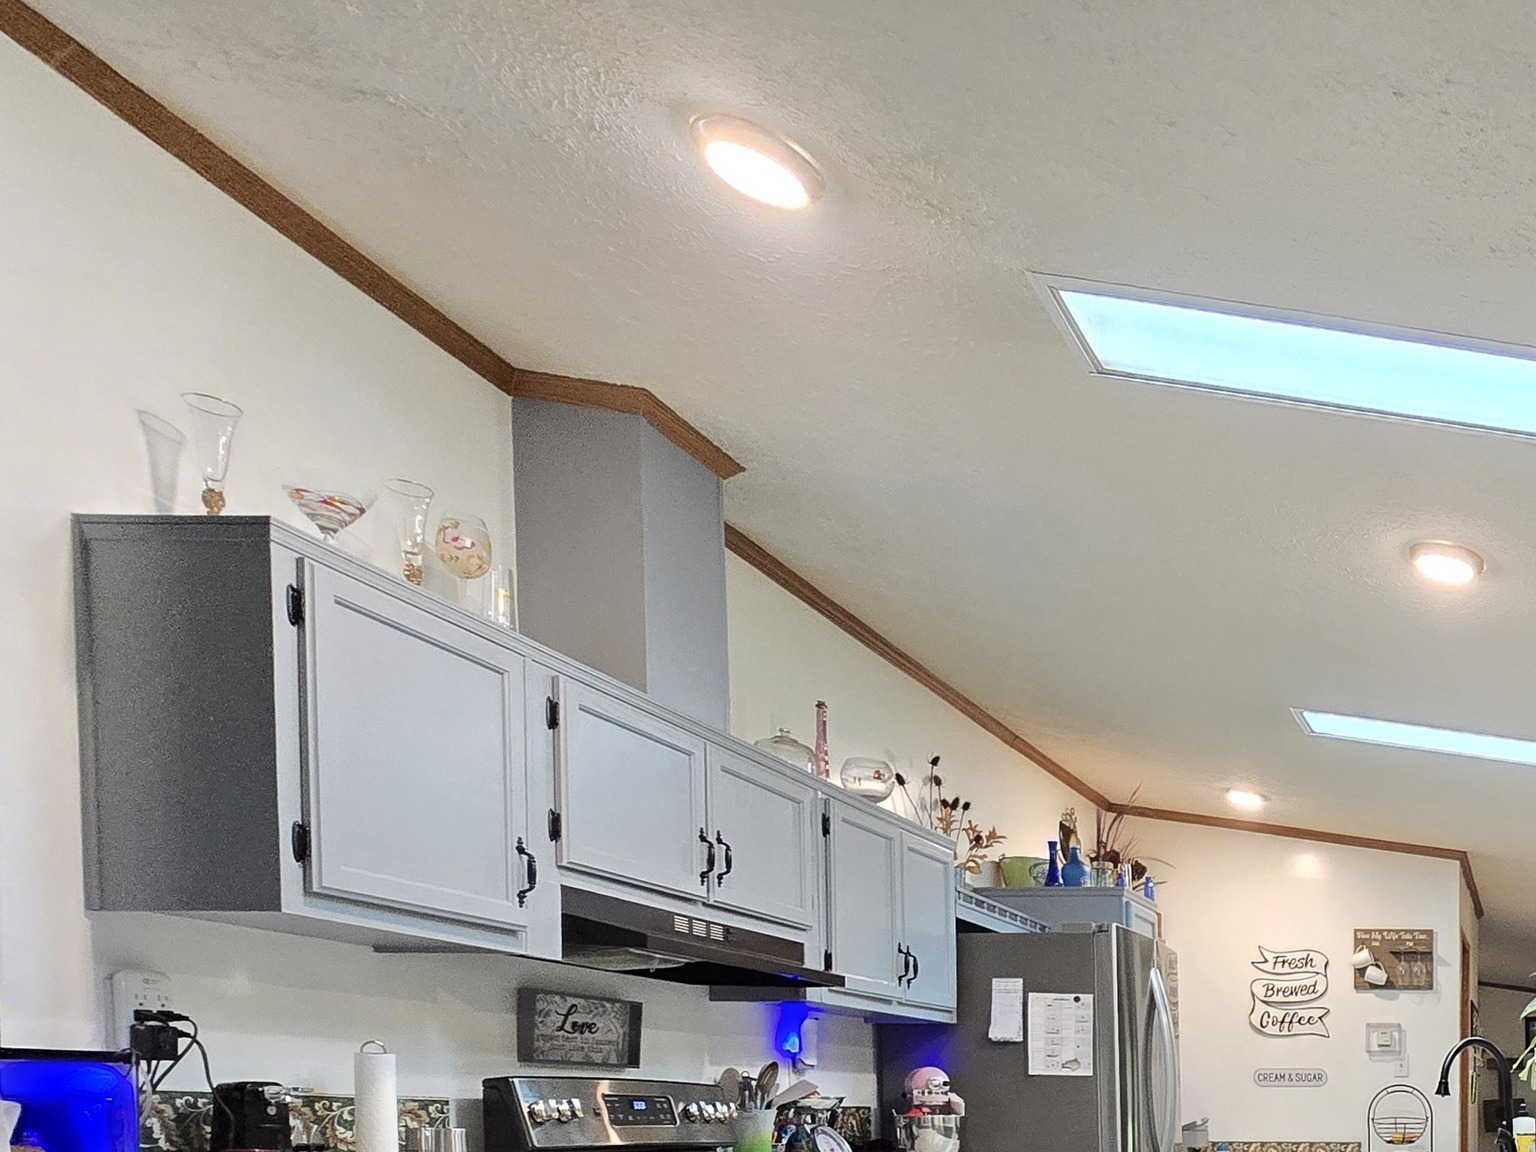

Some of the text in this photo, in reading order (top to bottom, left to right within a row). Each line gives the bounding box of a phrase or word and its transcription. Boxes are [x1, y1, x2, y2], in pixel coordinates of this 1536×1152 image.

[1272, 953, 1317, 970] Fresh
[1262, 980, 1319, 998] Brewed
[555, 1003, 600, 1035] Love
[1259, 1010, 1319, 1033] Coffee
[1257, 1072, 1324, 1083] CREAM & SUGAR
